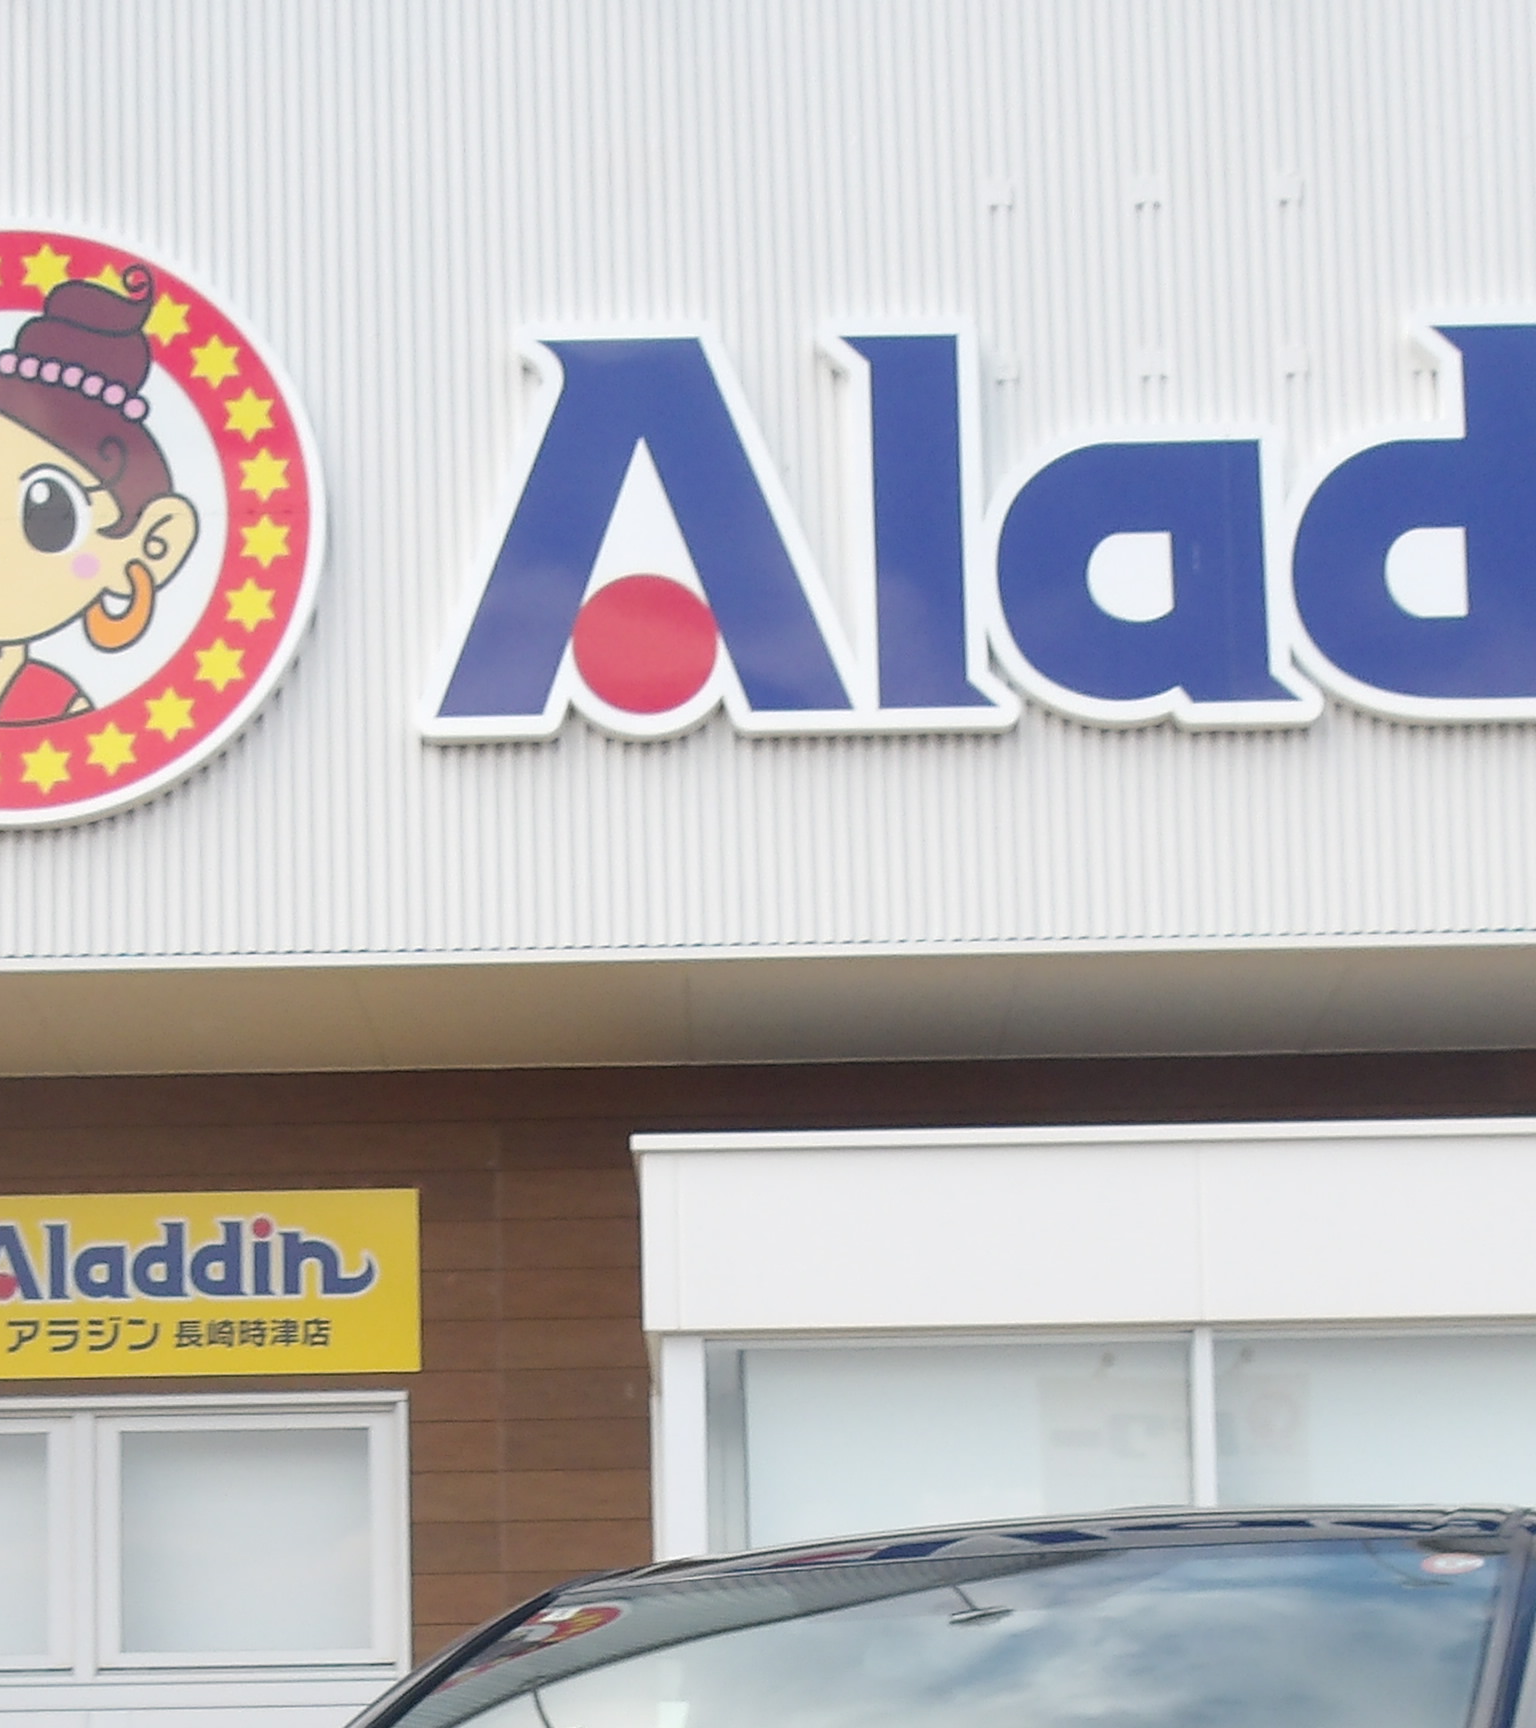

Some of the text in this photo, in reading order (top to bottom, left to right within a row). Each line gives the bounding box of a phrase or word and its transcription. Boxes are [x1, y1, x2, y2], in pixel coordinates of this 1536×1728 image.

[6, 1316, 332, 1354] アラジン 長崎時津店
